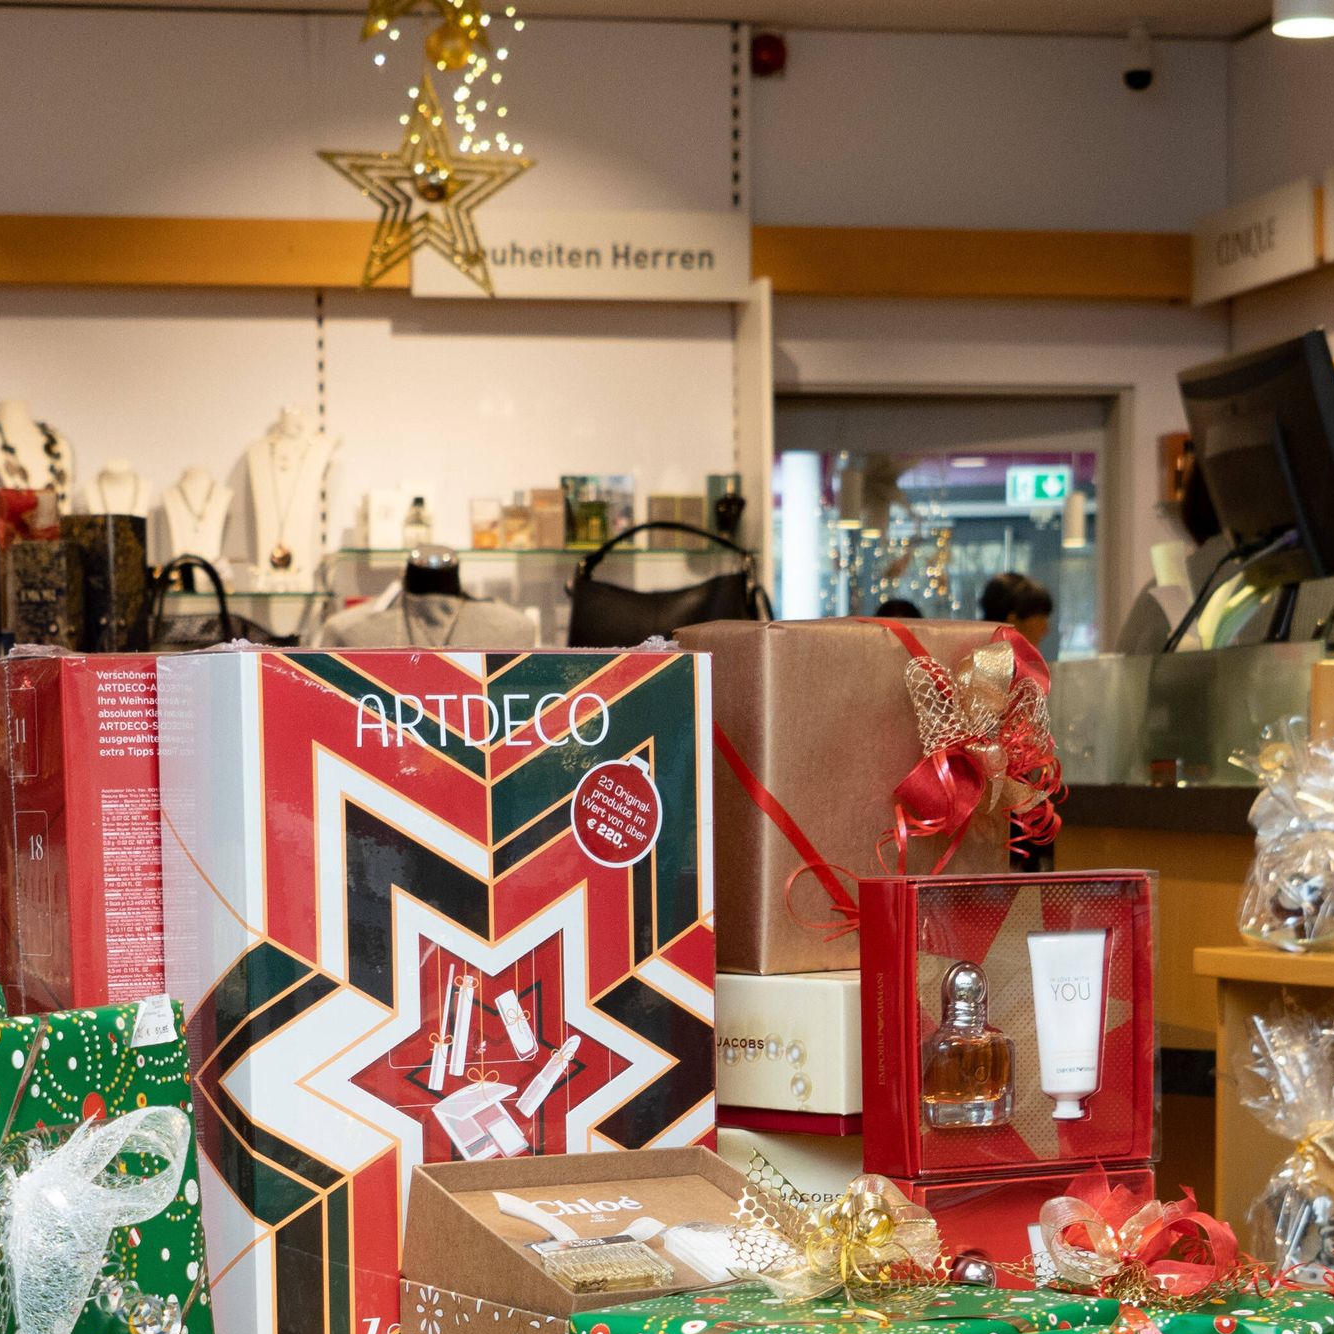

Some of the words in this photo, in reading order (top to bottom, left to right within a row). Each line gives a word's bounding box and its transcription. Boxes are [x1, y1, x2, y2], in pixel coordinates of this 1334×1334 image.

[479, 240, 602, 269] uheiten
[612, 242, 715, 271] Herren
[96, 670, 157, 680] Verschönern
[97, 696, 117, 706] Ihre
[98, 709, 143, 718] absoluten
[356, 692, 610, 748] ARTDECO
[99, 747, 125, 757] extra
[127, 747, 154, 757] Tipps
[598, 775, 614, 791] 23
[591, 789, 632, 818] produkte
[634, 812, 646, 827] im
[581, 795, 606, 818] Wert
[608, 813, 624, 829] von
[625, 823, 647, 842] über
[29, 834, 44, 861] 18
[1050, 983, 1091, 1002] YOU
[717, 1037, 764, 1050] JACOBS
[534, 1195, 643, 1217] Chloé
